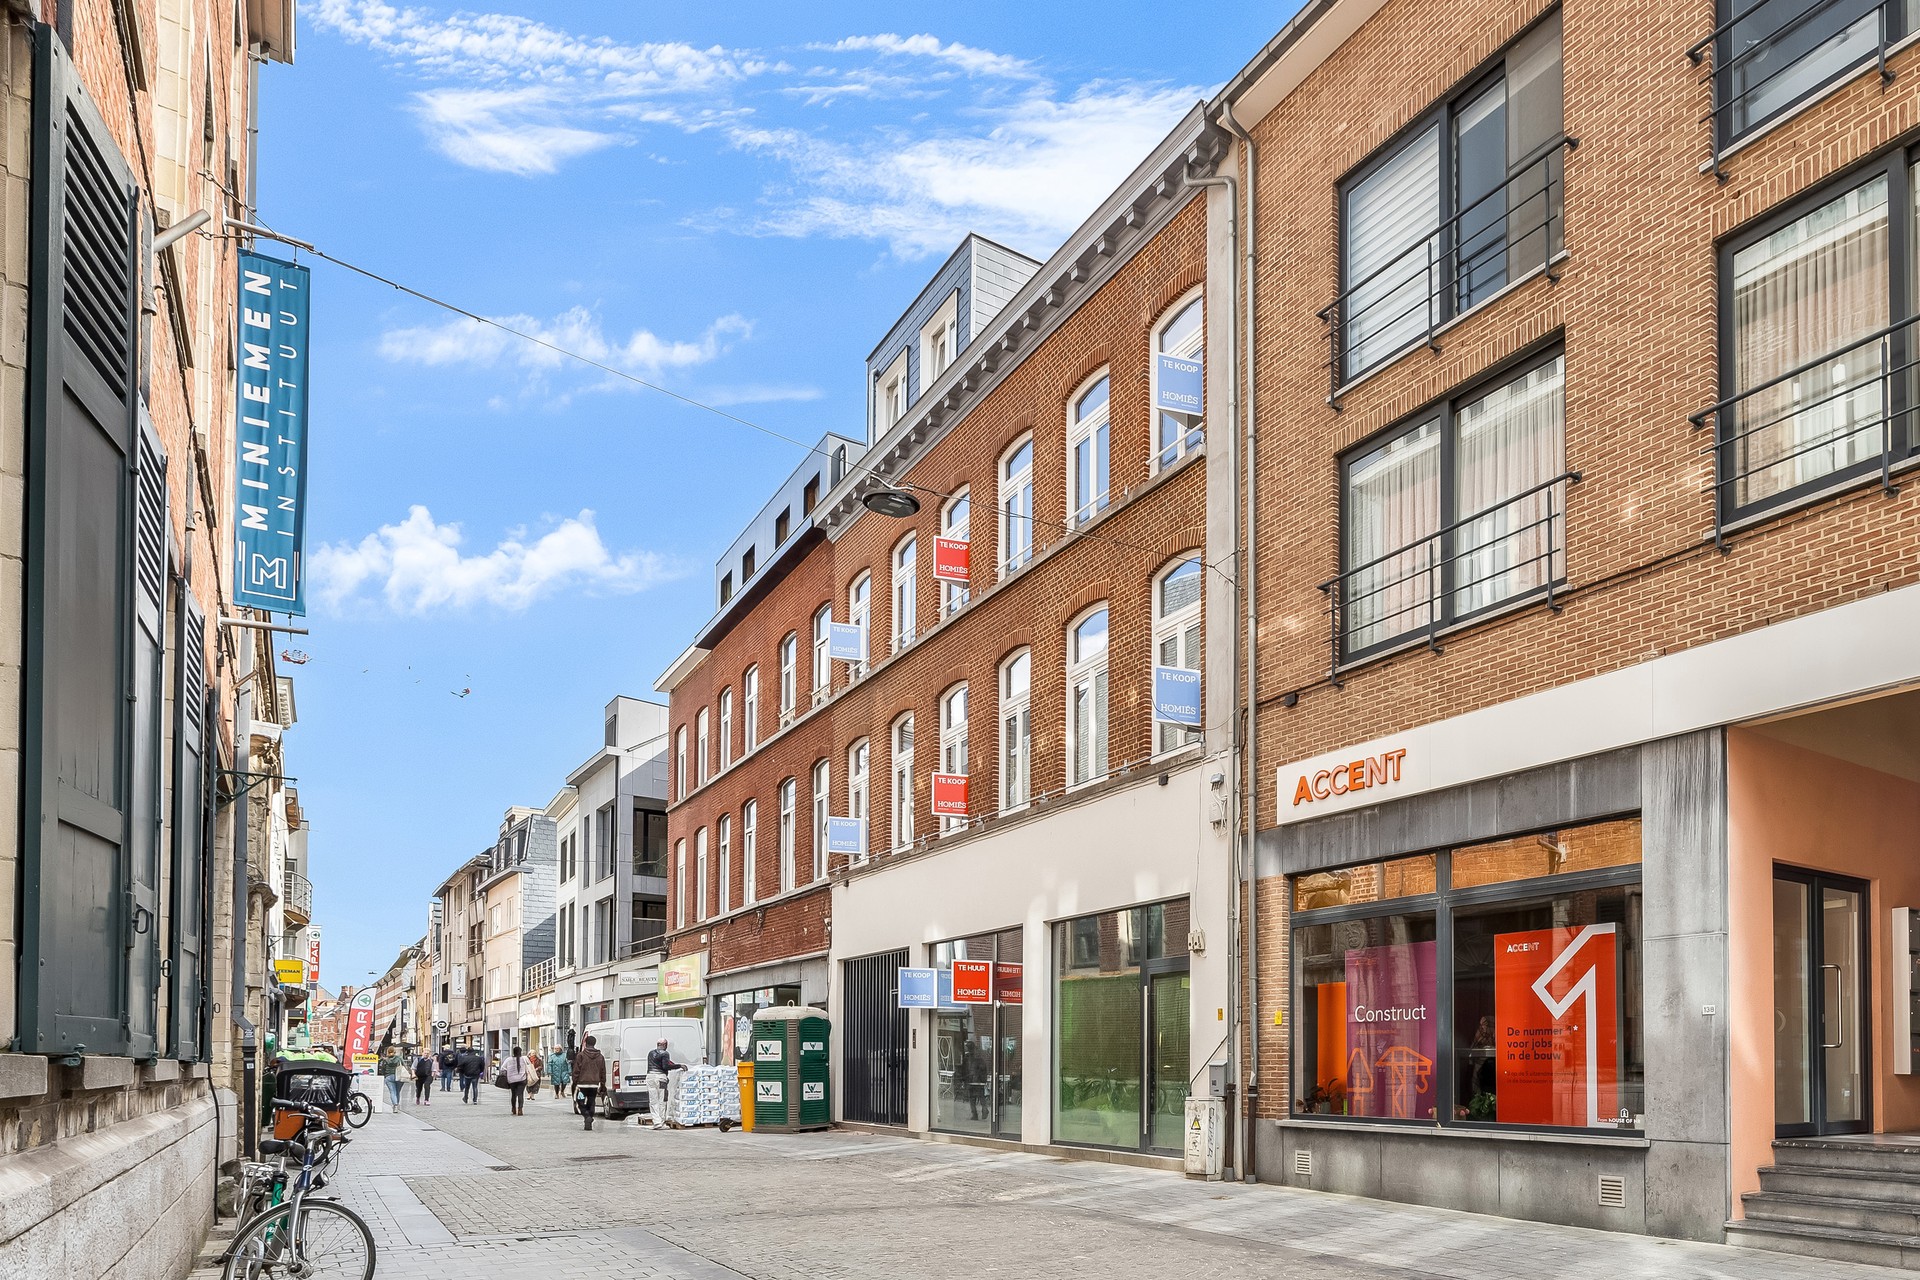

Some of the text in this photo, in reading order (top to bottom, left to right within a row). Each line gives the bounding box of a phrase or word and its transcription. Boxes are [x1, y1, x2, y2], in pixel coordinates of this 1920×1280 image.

[1162, 359, 1199, 373] TE KOOP
[241, 270, 271, 531] MINIEMEN
[276, 279, 298, 537] INSTITUUT
[939, 541, 968, 551] TE KOOP
[1160, 671, 1197, 683] TE KOOP
[1293, 748, 1406, 806] ACCENT
[1507, 942, 1540, 953] ACCENT
[311, 941, 319, 972] SPAR
[967, 964, 986, 972] HUUR
[1354, 1004, 1427, 1023] Construct
[352, 1011, 369, 1055] PAR
[1507, 1027, 1520, 1037] De
[1523, 1028, 1563, 1036] nummer
[1507, 1039, 1552, 1050] voor jobs
[1507, 1051, 1561, 1060] in de bouw
